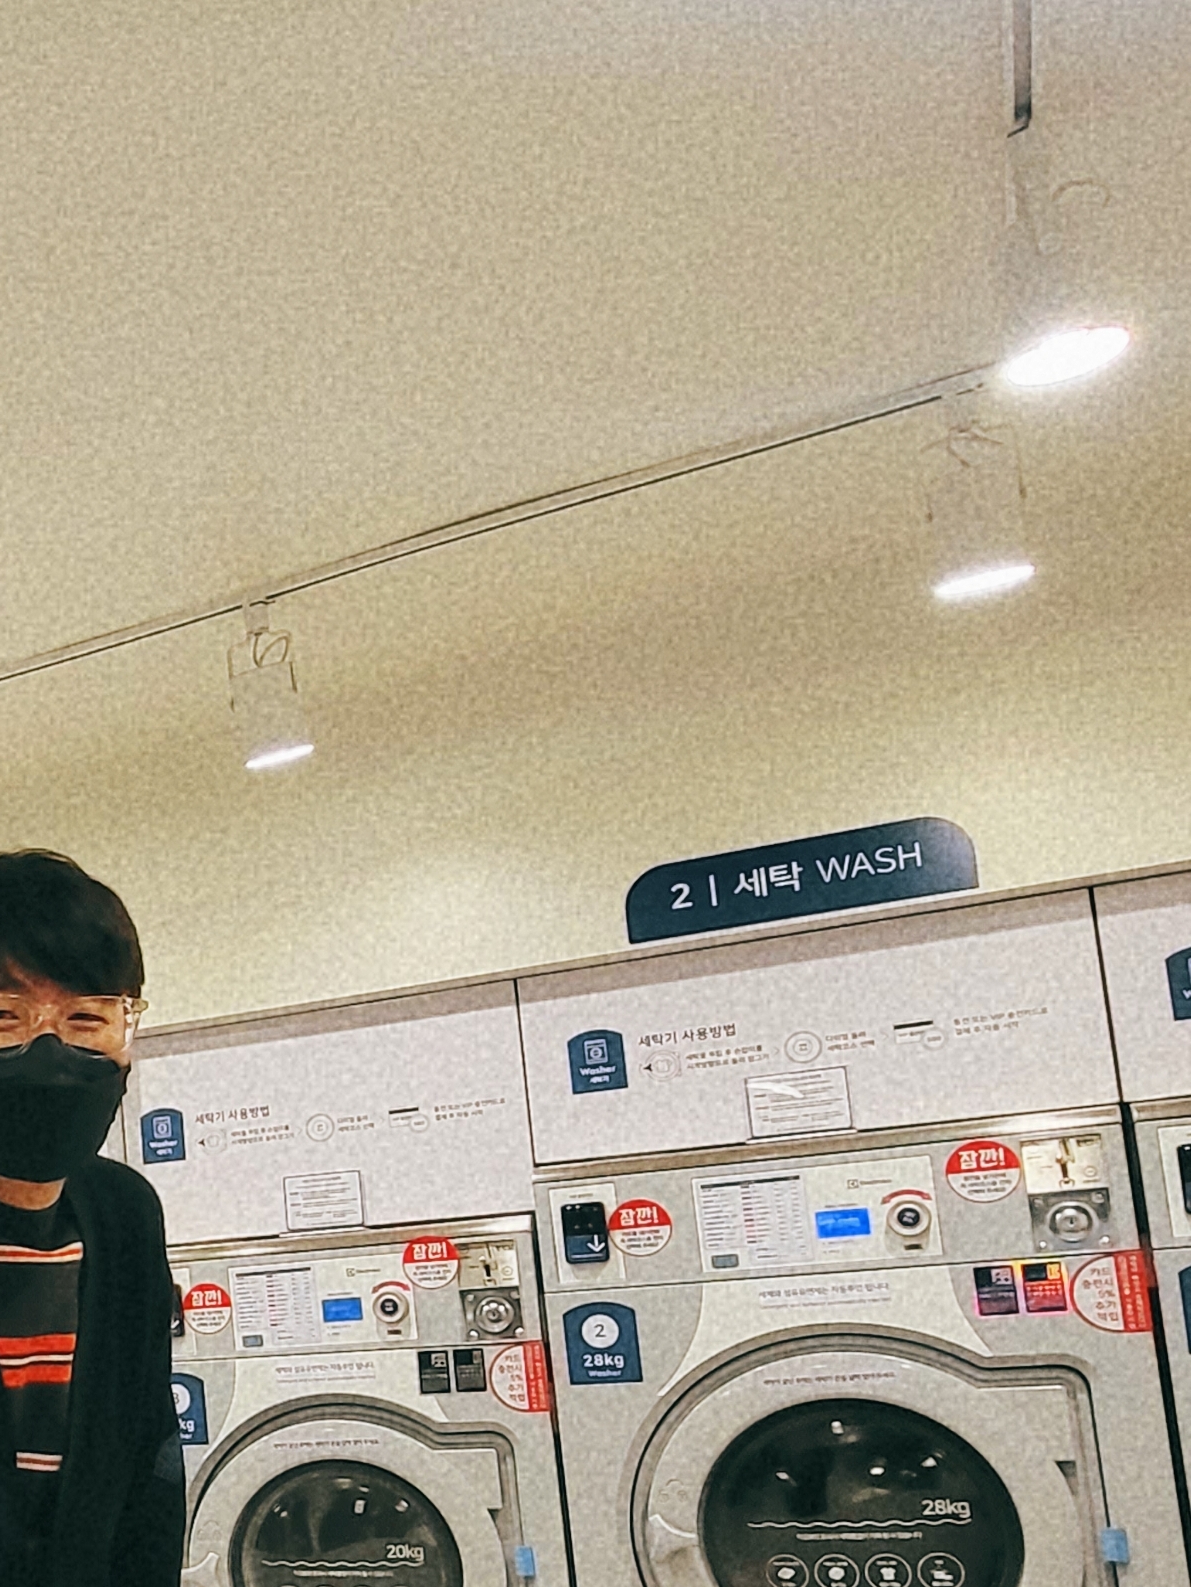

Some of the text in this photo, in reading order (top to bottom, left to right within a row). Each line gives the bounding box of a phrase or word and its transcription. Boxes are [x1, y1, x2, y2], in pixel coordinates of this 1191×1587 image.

[670, 841, 922, 910] 2 세탁 WASH
[638, 1023, 737, 1048] 세탁기 사용방법
[579, 1065, 616, 1076] Washer
[195, 1106, 270, 1124] 세탁기 사용방법
[958, 1147, 1006, 1170] 잠깐!
[618, 1206, 659, 1226] 잠깐!
[412, 1241, 448, 1260] 잠깐!
[191, 1290, 222, 1306] 잠깐!
[594, 1324, 606, 1338] 2
[583, 1353, 624, 1369] 28kg
[178, 1418, 195, 1432] kg
[921, 1499, 971, 1519] 28kg
[386, 1544, 424, 1561] 20kg
